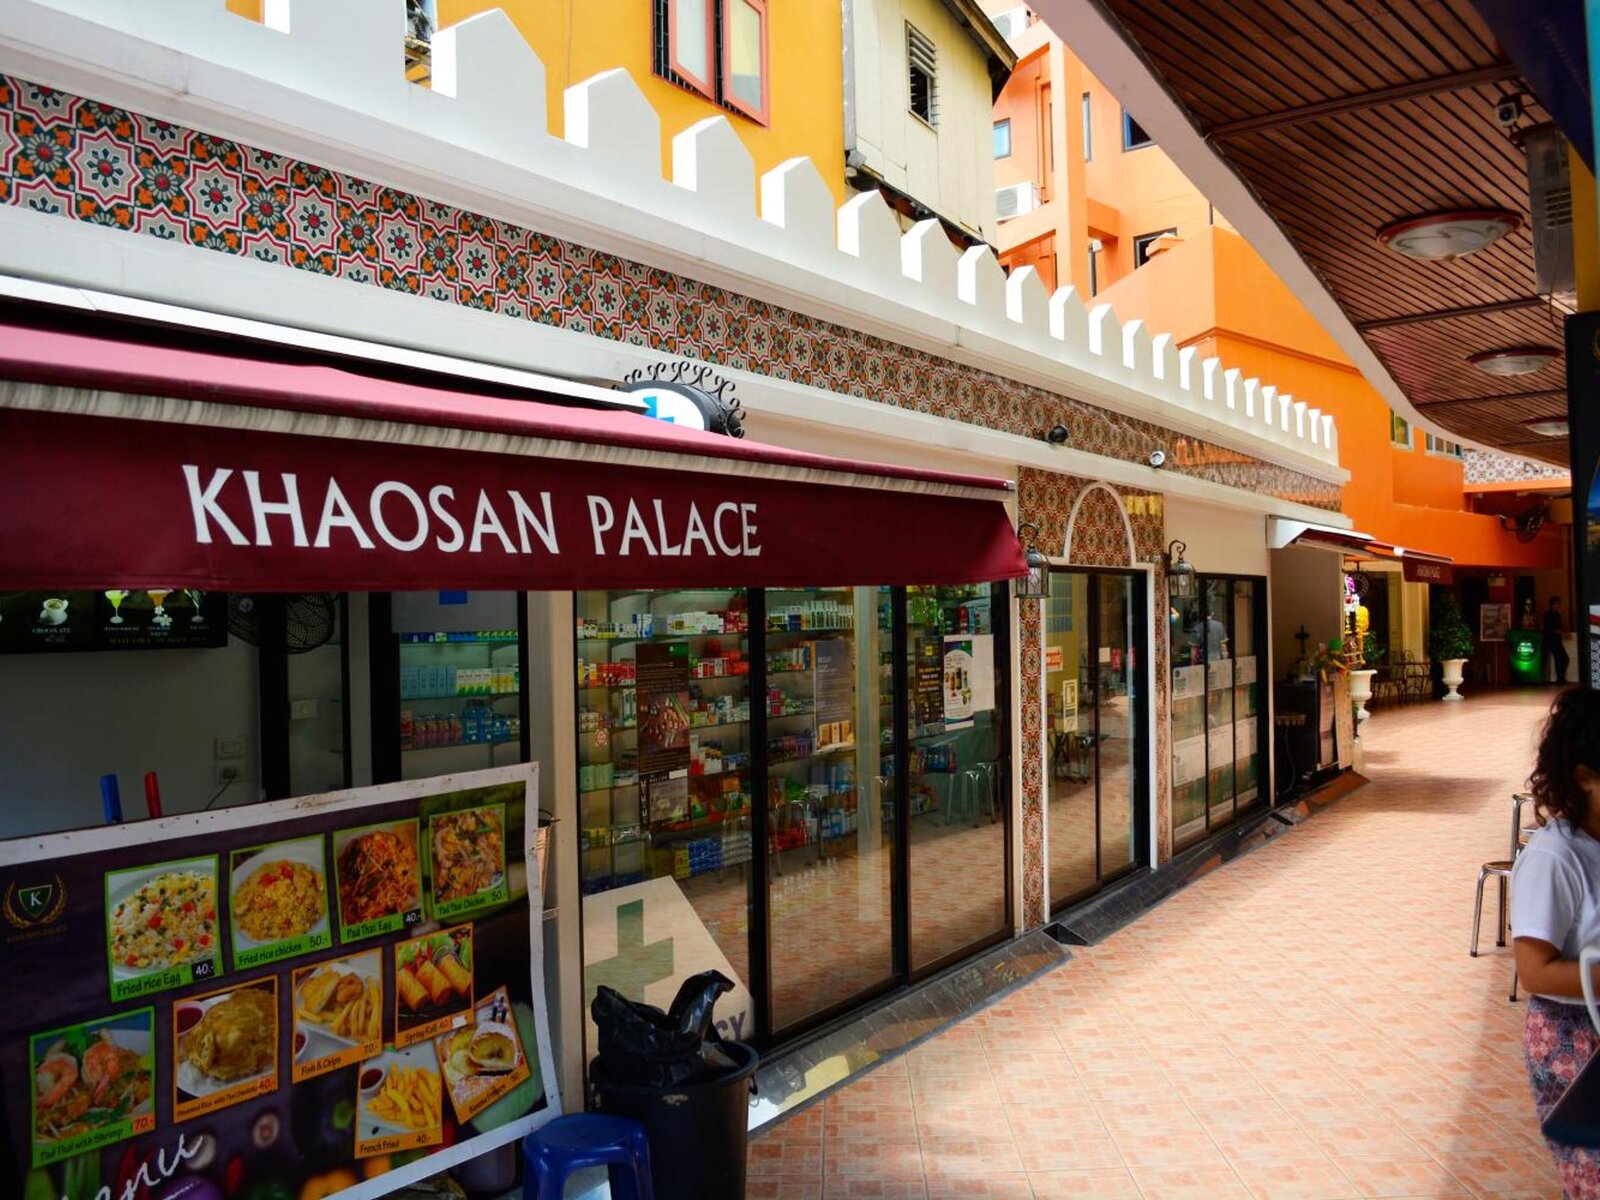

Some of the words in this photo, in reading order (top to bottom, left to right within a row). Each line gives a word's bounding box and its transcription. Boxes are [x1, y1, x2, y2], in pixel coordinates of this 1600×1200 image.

[182, 464, 561, 554] KHAOSAN
[586, 494, 762, 558] PALACE
[30, 890, 43, 907] K
[347, 927, 361, 938] Pad
[361, 923, 377, 935] Thai
[379, 920, 393, 932] Egg
[239, 952, 259, 966] Fried
[259, 949, 275, 960] rice
[275, 942, 302, 956] chicken
[117, 980, 142, 997] Fried
[144, 976, 163, 989] rice
[163, 972, 181, 985] Egg
[301, 1062, 316, 1076] Fish
[323, 1056, 342, 1069] Chips
[360, 1142, 382, 1154] French
